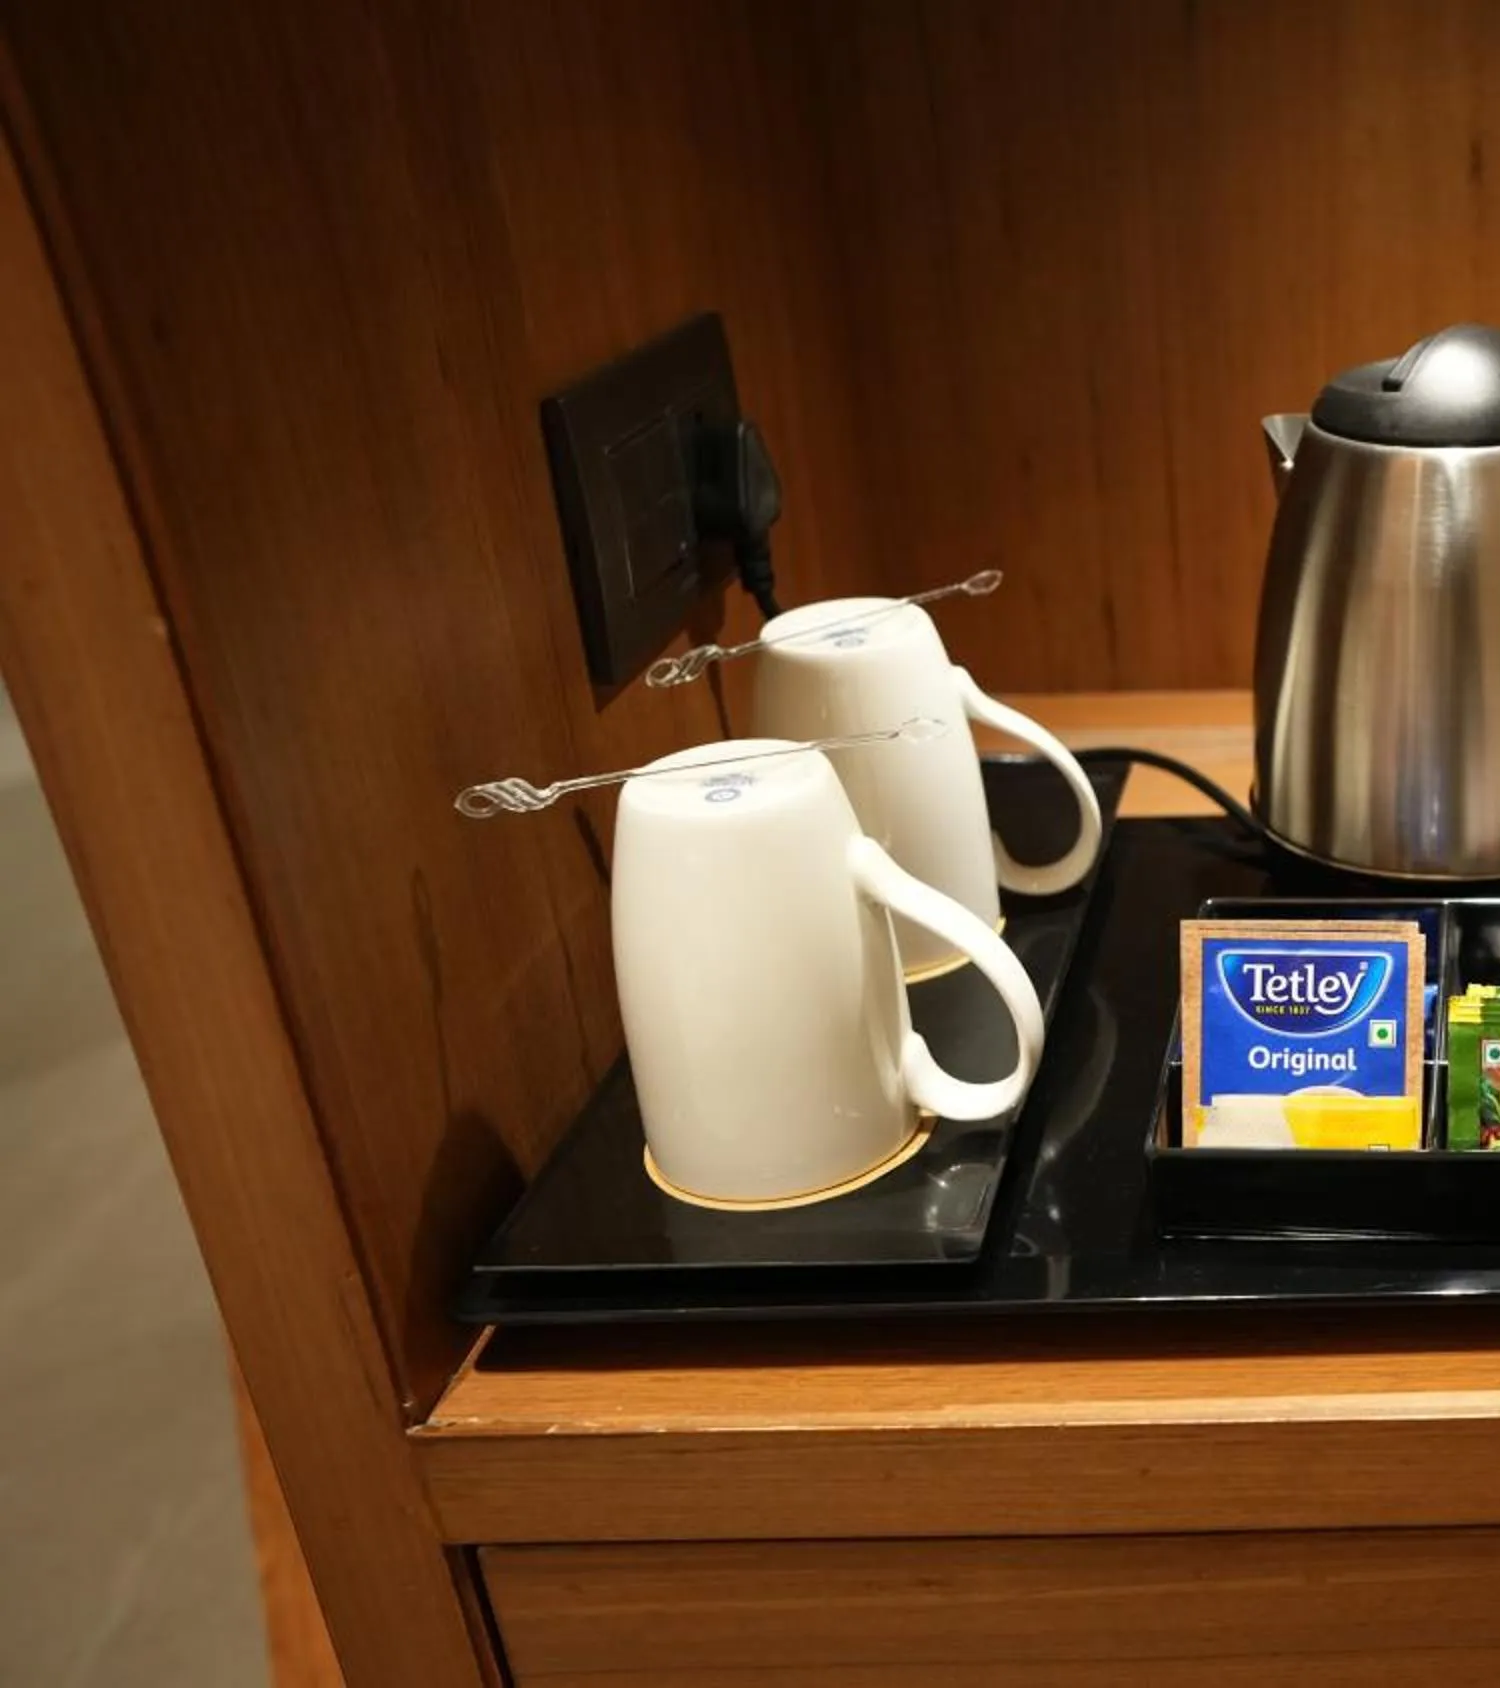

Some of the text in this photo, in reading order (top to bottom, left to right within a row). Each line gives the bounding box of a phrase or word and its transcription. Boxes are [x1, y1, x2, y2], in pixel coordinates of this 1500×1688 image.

[1242, 962, 1366, 1015] Tetley
[1255, 1004, 1285, 1015] SINCE
[1248, 1045, 1358, 1077] Original
